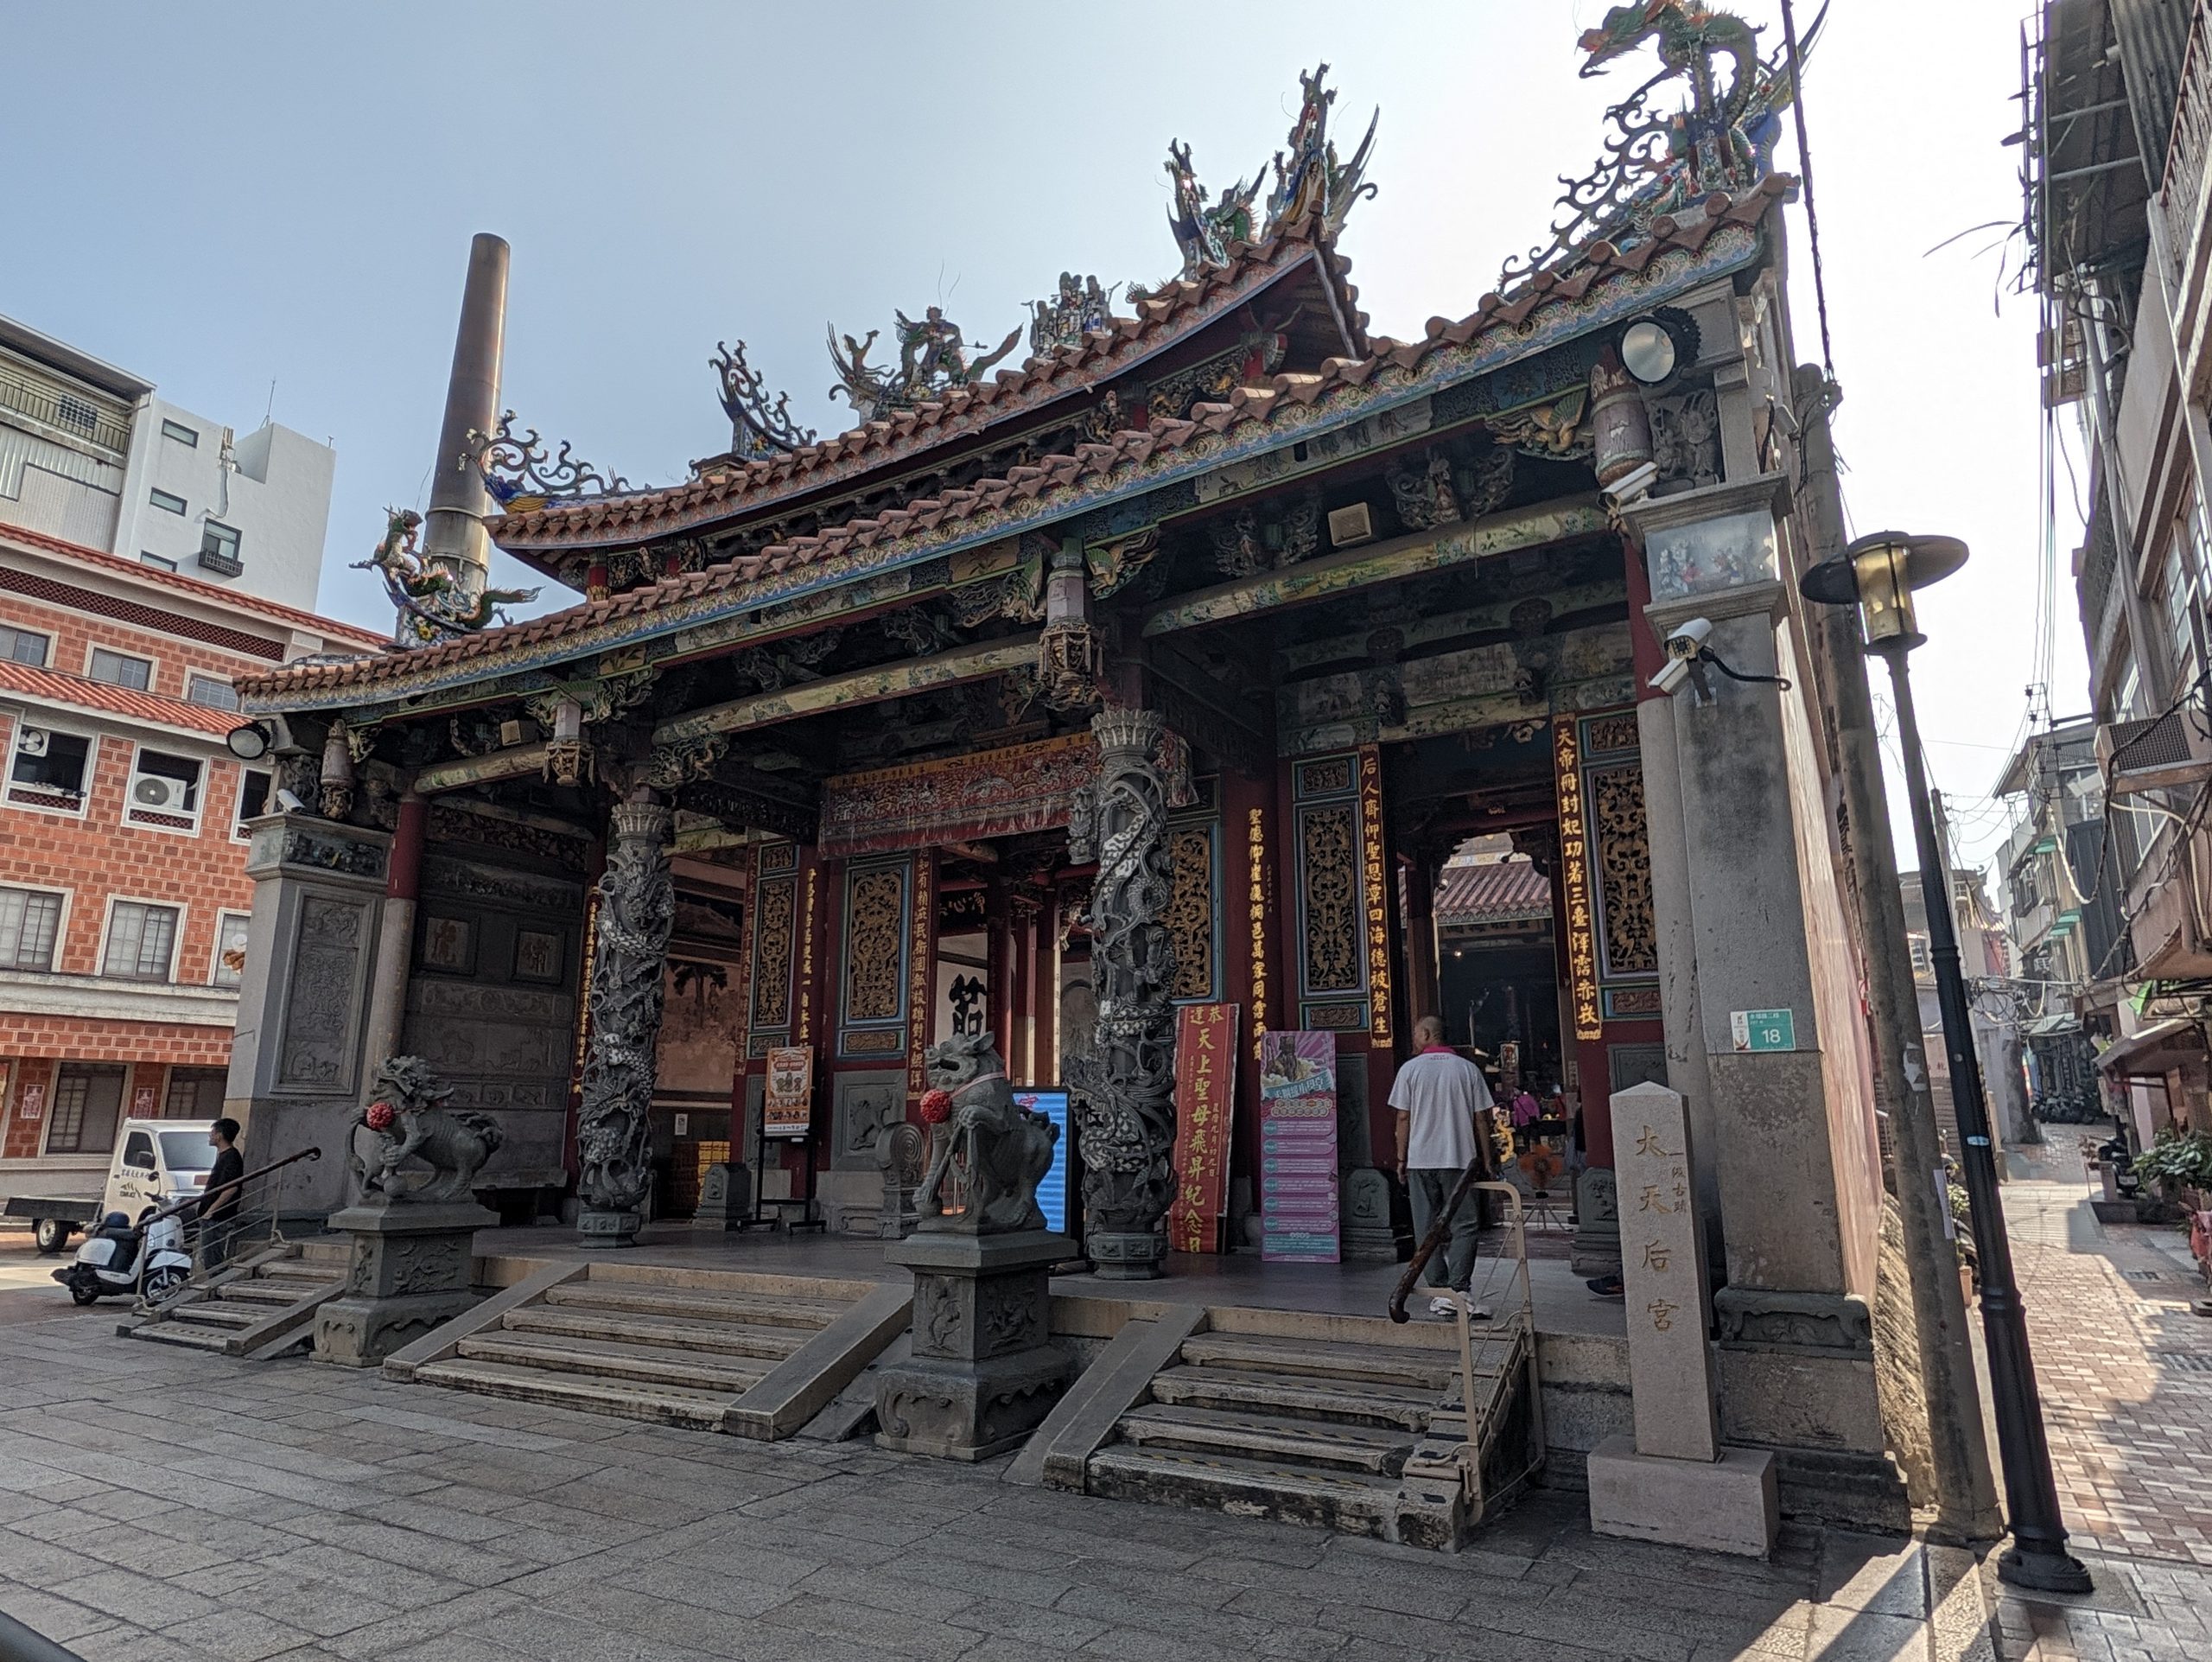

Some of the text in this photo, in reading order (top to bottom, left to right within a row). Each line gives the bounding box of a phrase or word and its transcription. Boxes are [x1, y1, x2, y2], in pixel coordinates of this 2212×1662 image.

[1184, 1028, 1216, 1253] 天上聖母飛昇紀念日
[1762, 1028, 1781, 1044] 18
[1635, 1124, 1680, 1333] 大天后宮
